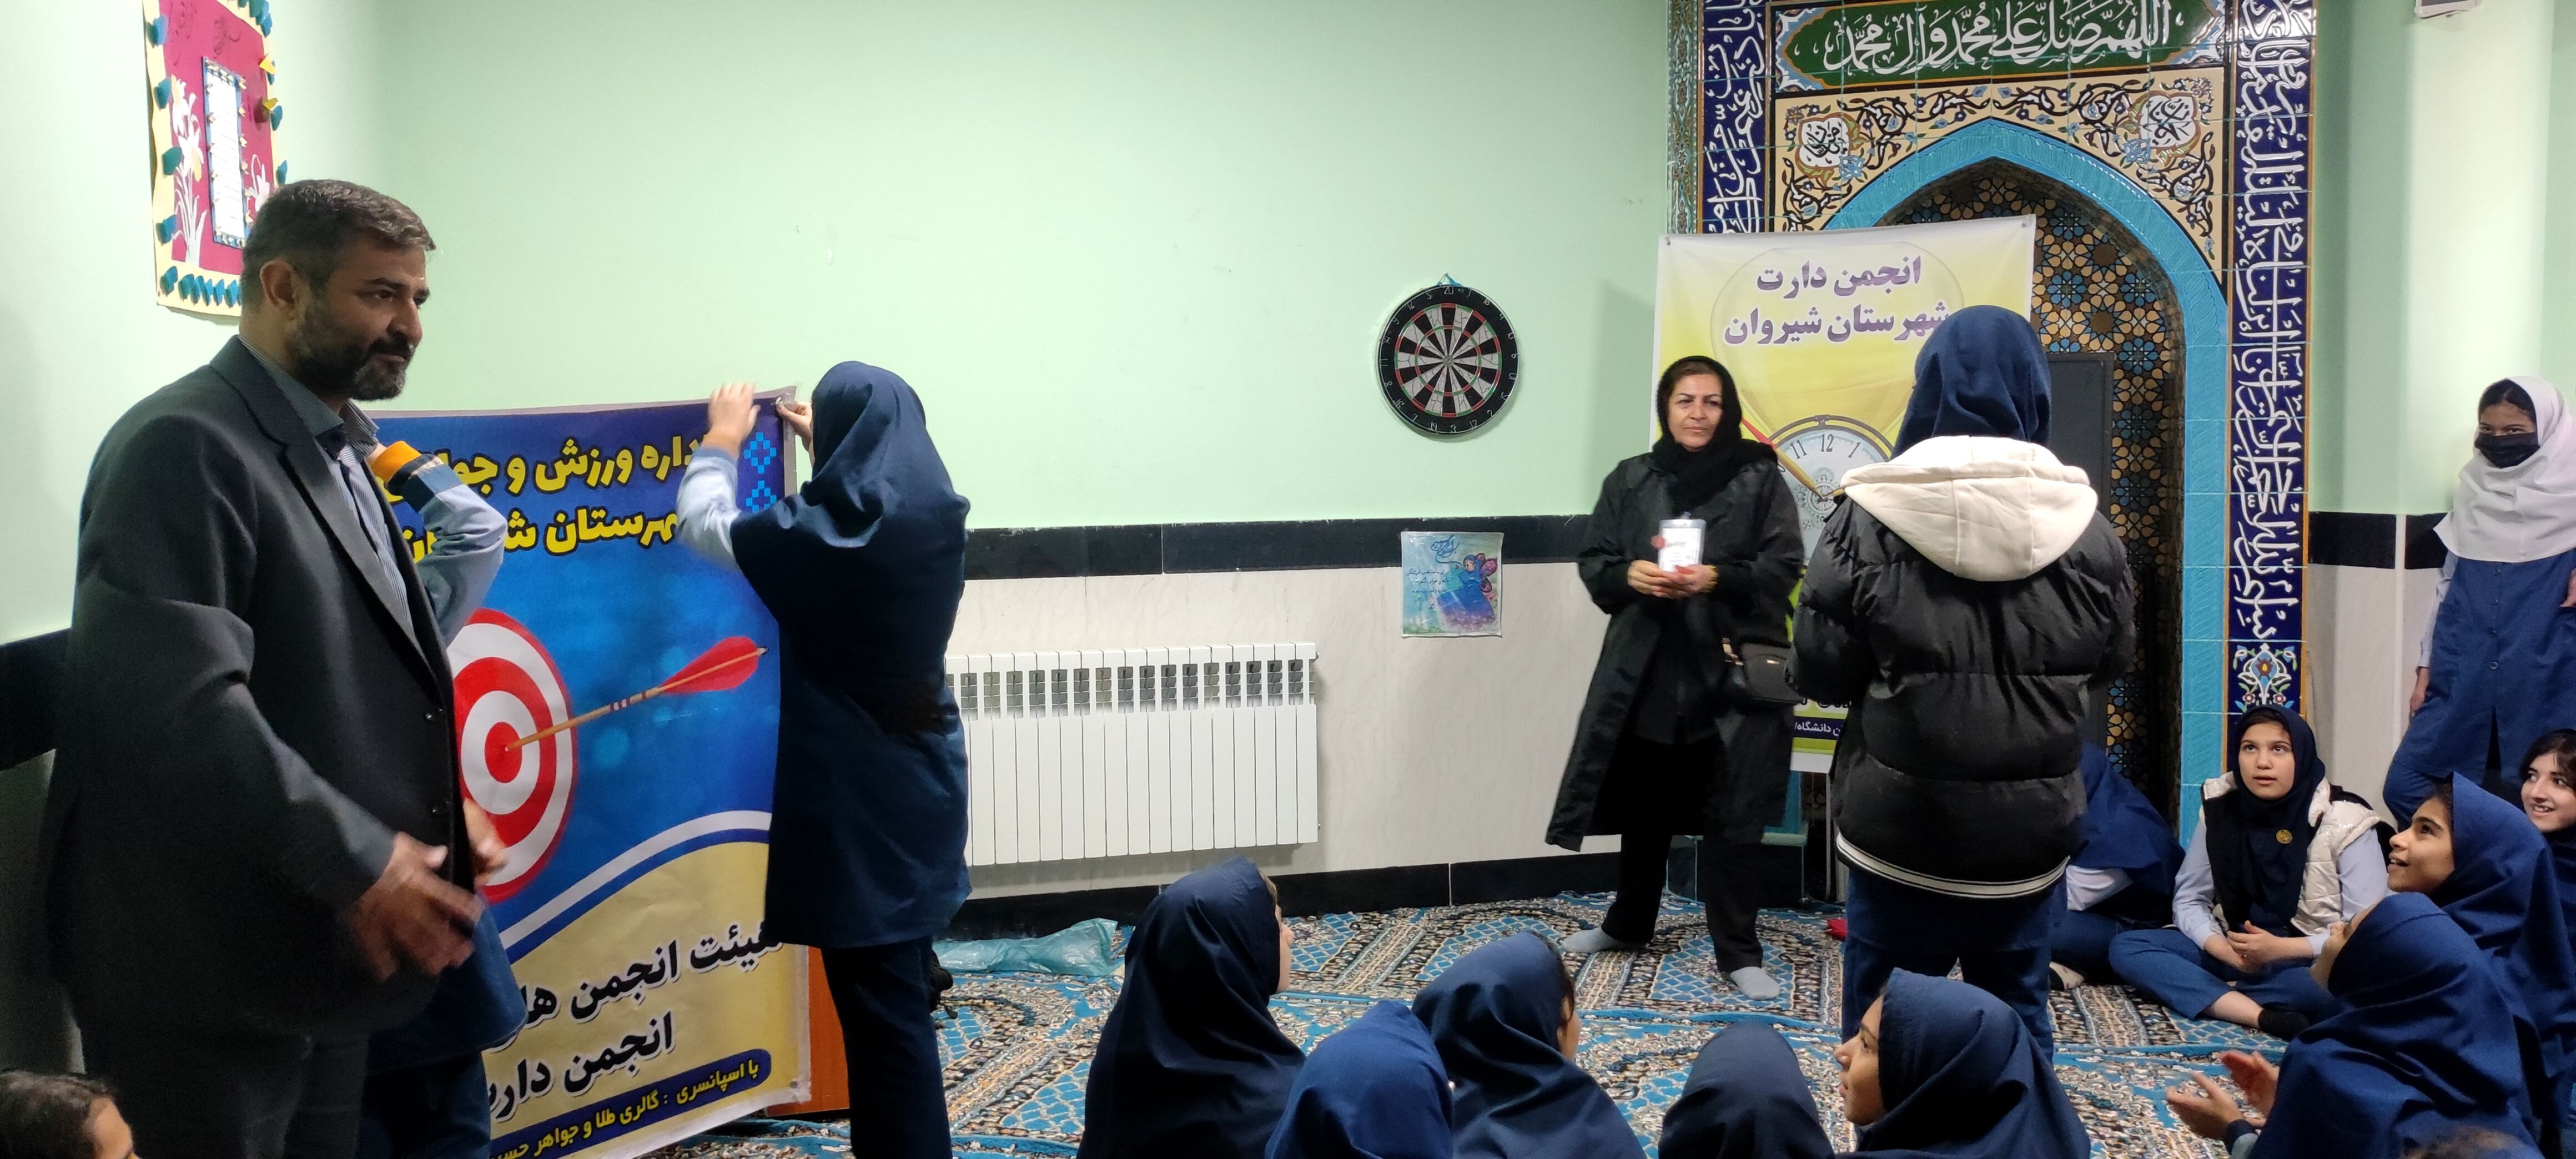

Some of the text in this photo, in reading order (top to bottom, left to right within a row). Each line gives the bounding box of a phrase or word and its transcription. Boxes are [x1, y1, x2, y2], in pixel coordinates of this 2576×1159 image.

[1443, 286, 1454, 295] 20
[1757, 255, 1921, 299] انجمن دارت
[1724, 301, 1949, 344] شهرستان شیروان
[1789, 439, 1808, 460] 11
[1820, 434, 1834, 452] 12
[1847, 442, 1861, 458] 1
[507, 457, 526, 495] و
[536, 439, 633, 492] ورزش
[546, 508, 678, 553] هرستان
[690, 921, 772, 970] یئت
[571, 940, 677, 1020] انجمن
[564, 1011, 672, 1093] انجمن
[748, 1059, 759, 1079] با
[676, 1062, 745, 1105] اسپانسری
[596, 1108, 616, 1128] طلا
[620, 1089, 660, 1124] گالری
[534, 1125, 579, 1157] جواهر
[583, 1121, 592, 1138] و
